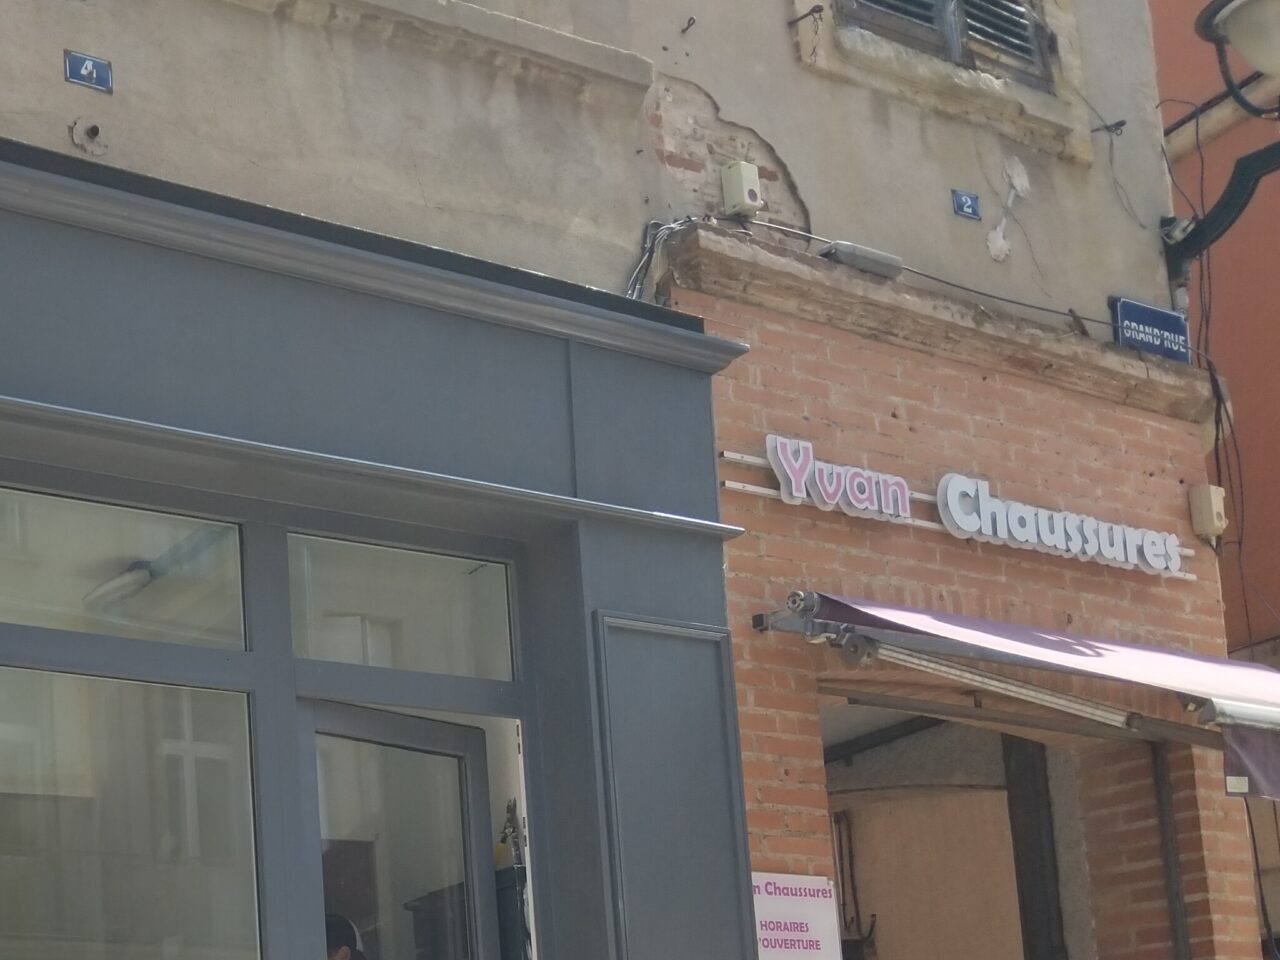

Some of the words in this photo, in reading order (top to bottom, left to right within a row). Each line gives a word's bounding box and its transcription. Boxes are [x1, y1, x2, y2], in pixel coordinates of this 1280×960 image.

[80, 60, 96, 83] 4
[962, 196, 972, 213] 2
[1123, 320, 1186, 352] GRAND'RUE
[770, 435, 911, 520] Yvan
[940, 472, 1182, 574] Chaussures
[764, 882, 832, 899] Chaussures
[760, 920, 809, 932] HORAIRES
[759, 938, 821, 950] 'OUVERTURE
